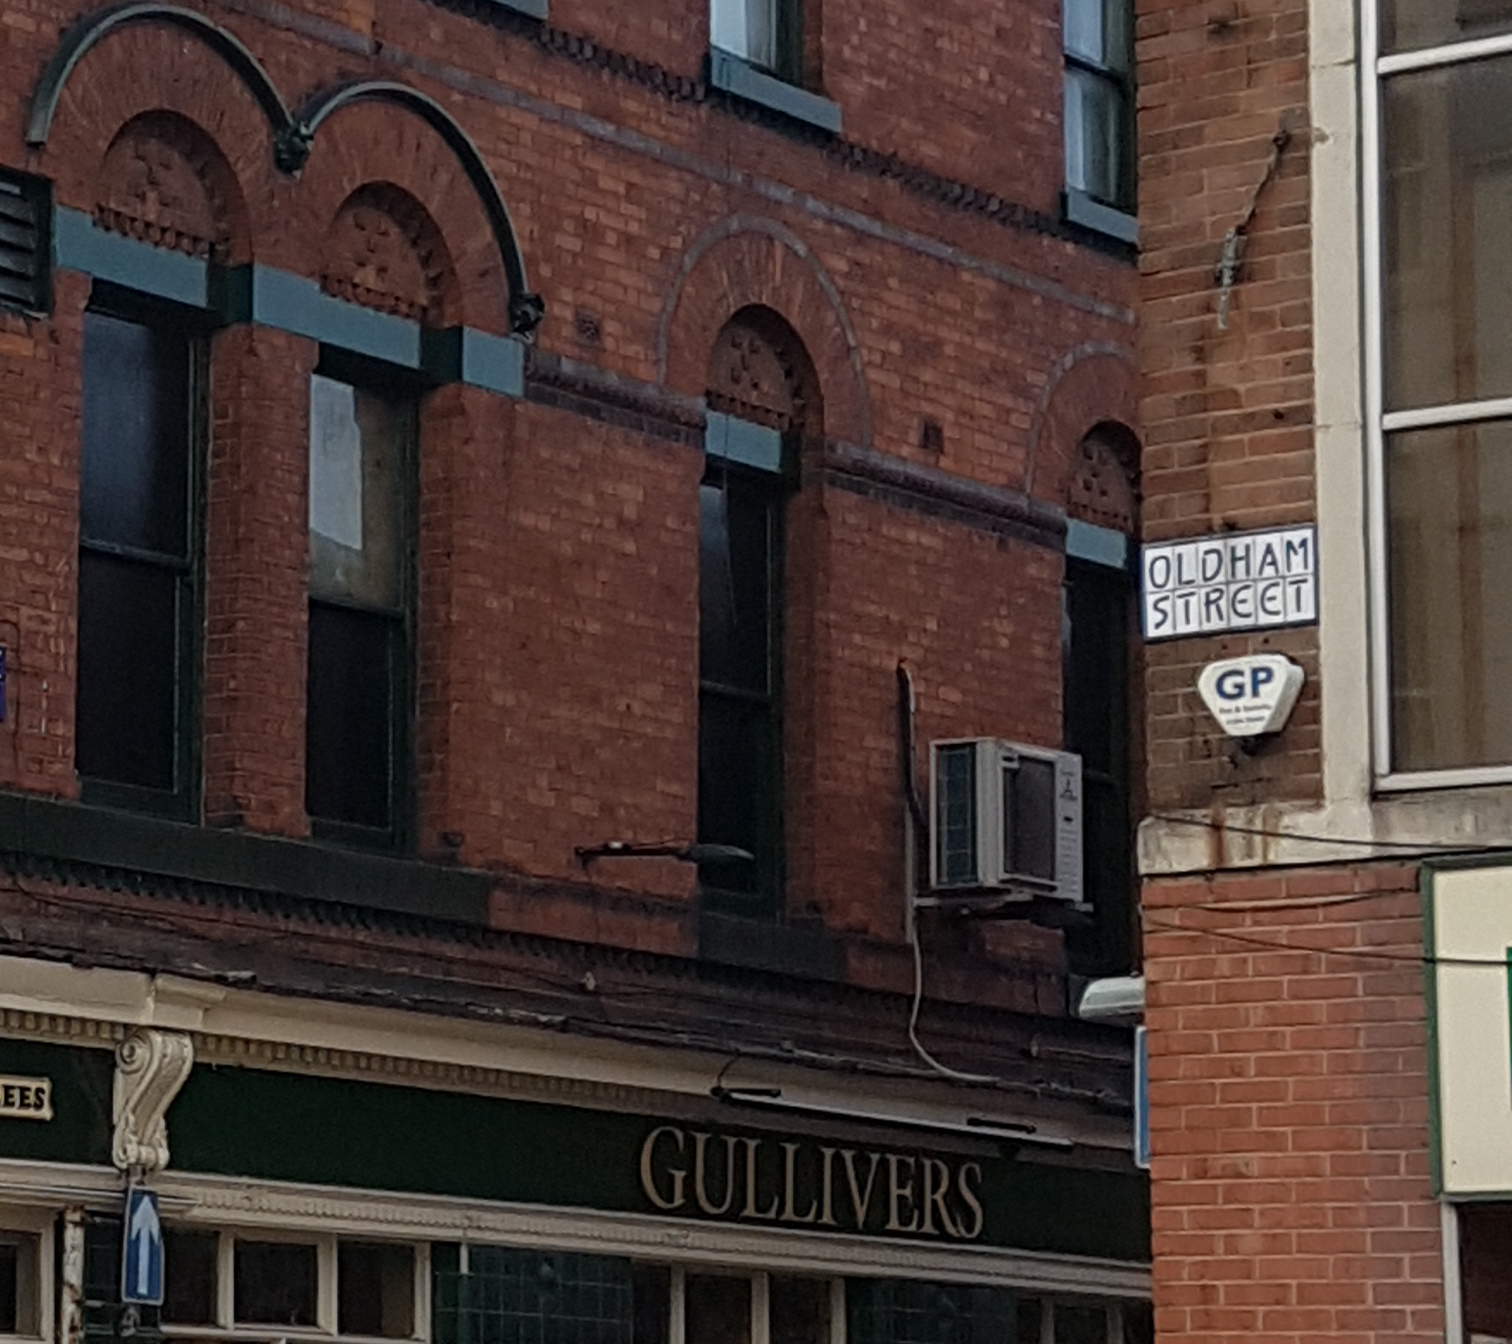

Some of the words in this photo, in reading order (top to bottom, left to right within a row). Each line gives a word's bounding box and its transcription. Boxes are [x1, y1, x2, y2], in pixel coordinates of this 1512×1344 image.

[1149, 537, 1309, 589] OLDHAM
[1152, 577, 1309, 630] STREET
[1215, 665, 1274, 700] GP
[640, 1125, 984, 1240] GULLIVERS
